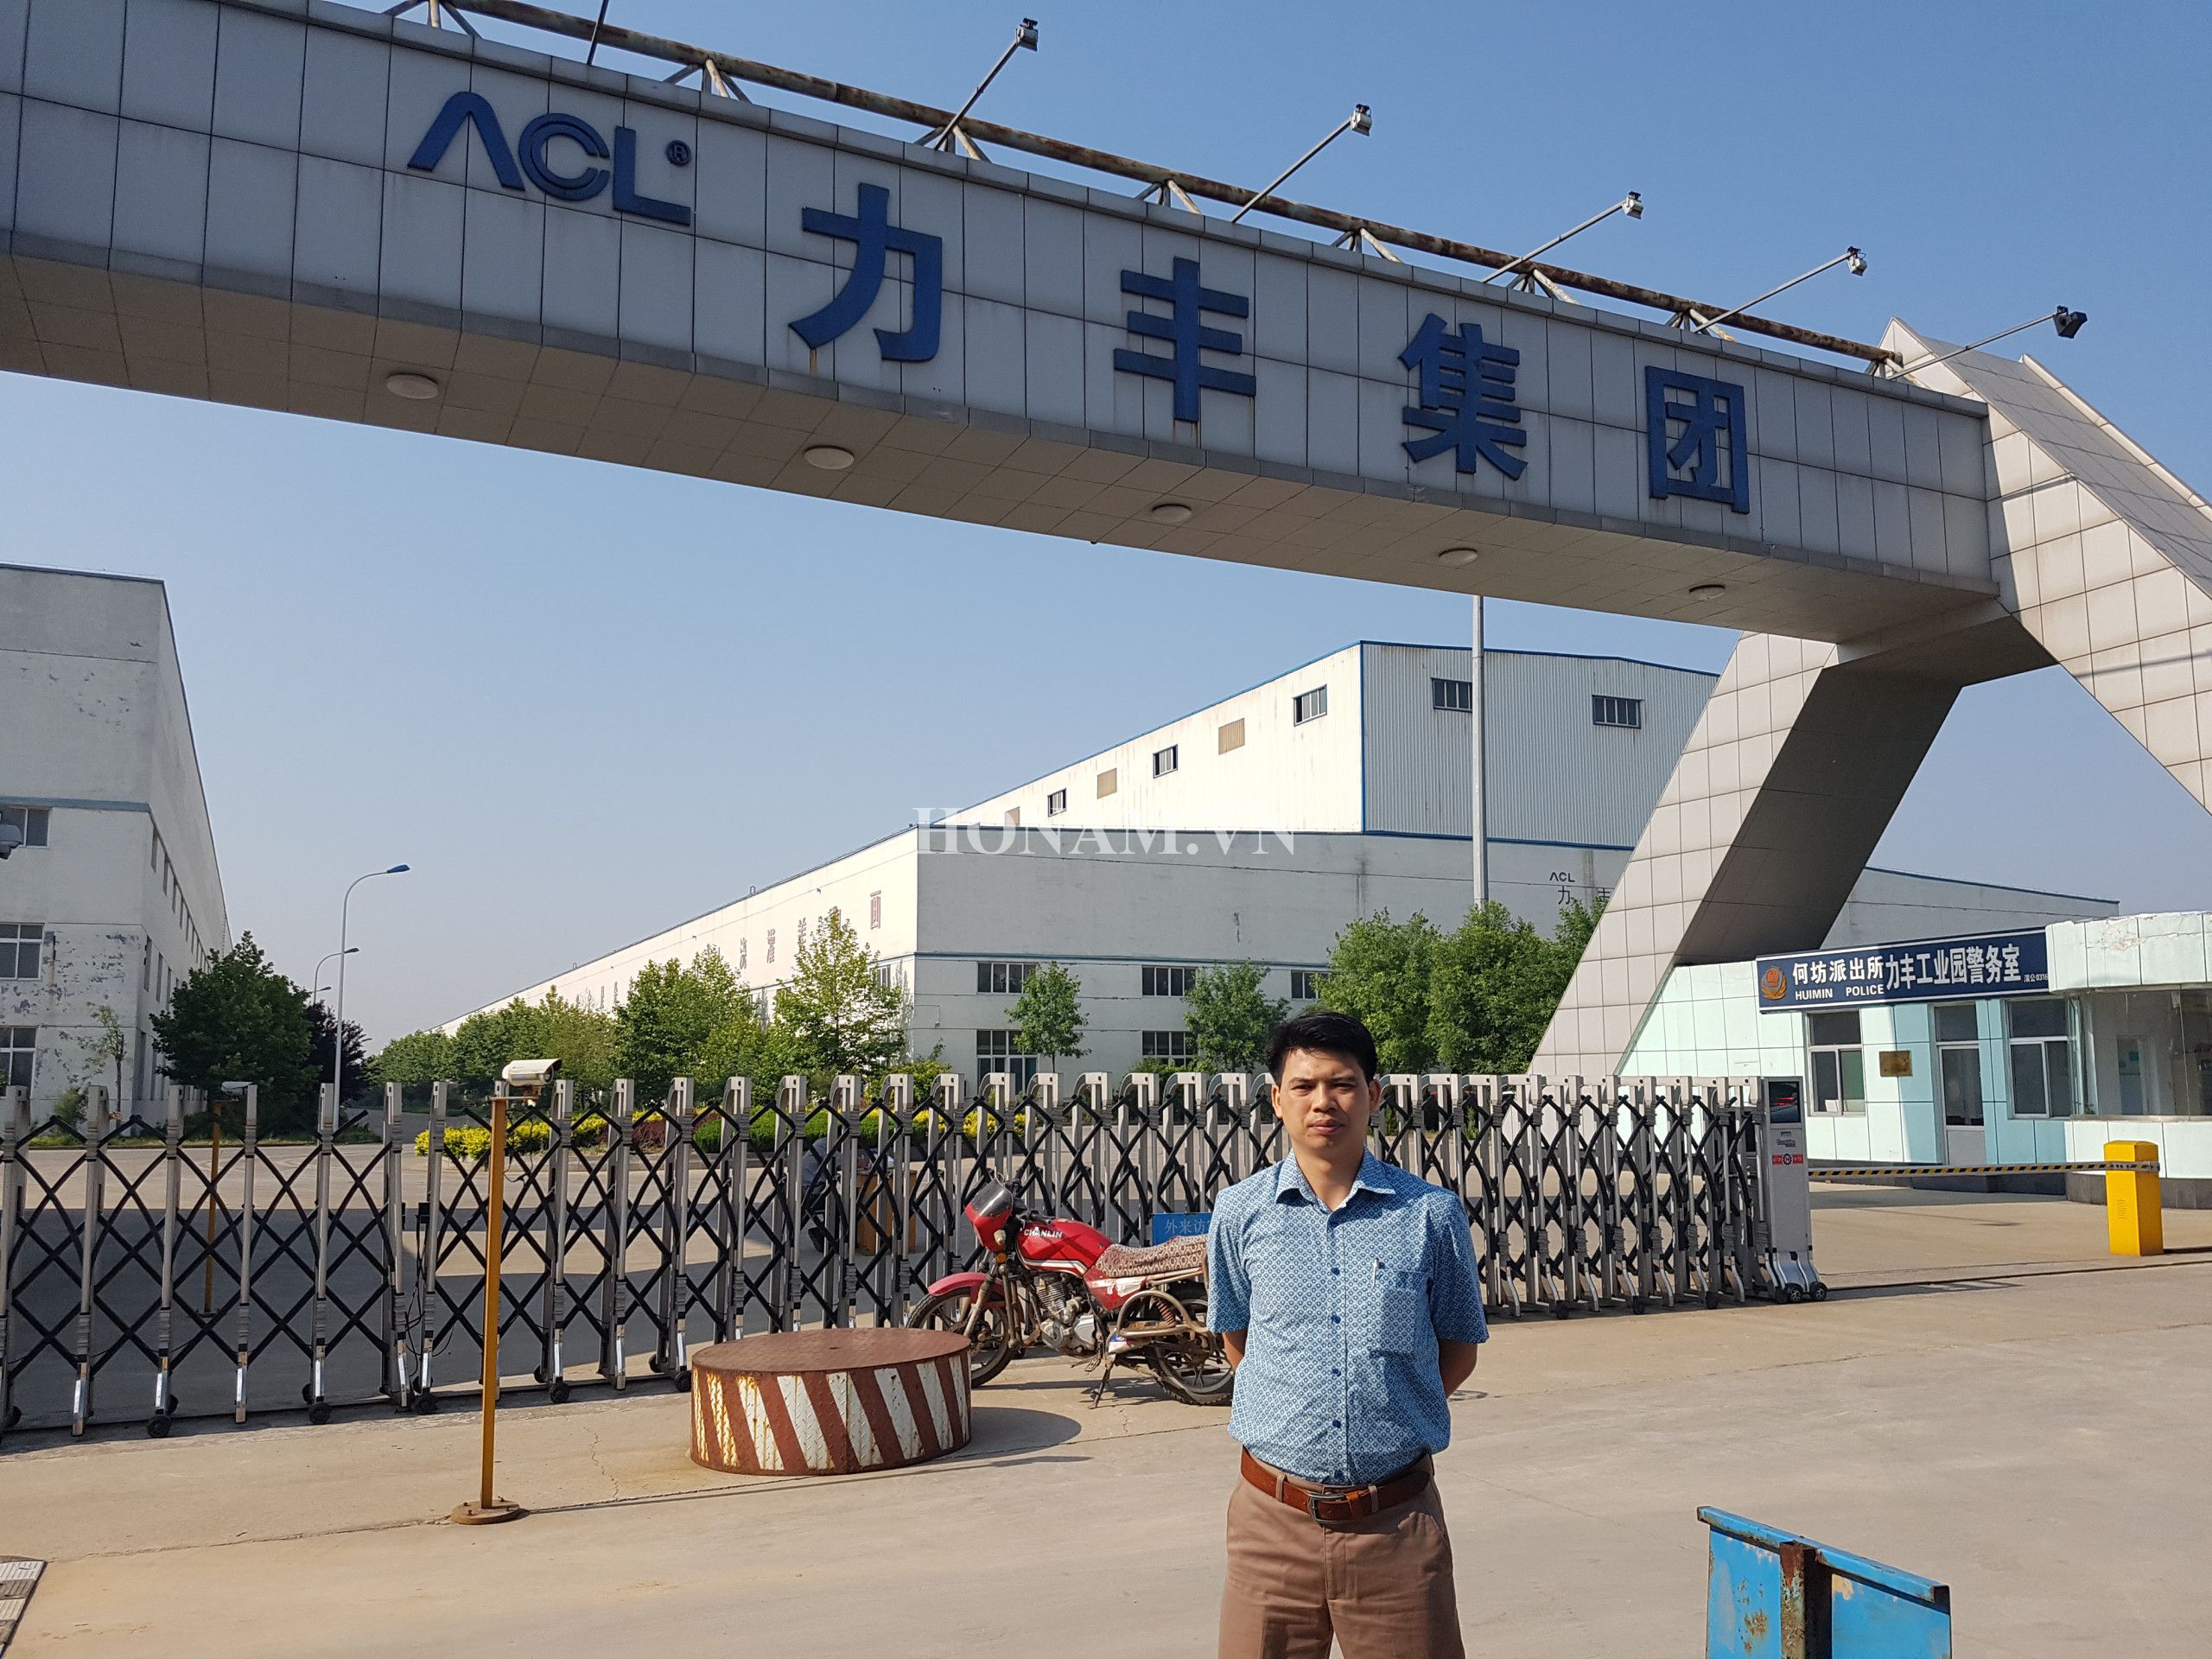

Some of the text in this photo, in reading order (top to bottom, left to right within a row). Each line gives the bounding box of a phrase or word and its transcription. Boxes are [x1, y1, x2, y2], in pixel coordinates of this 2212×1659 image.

[787, 181, 1751, 515] 力丰集团
[1549, 871, 1575, 882] ACL
[1795, 984, 1885, 1000] HUIMIN POLICE
[1164, 1218, 1211, 1235] 外来访
